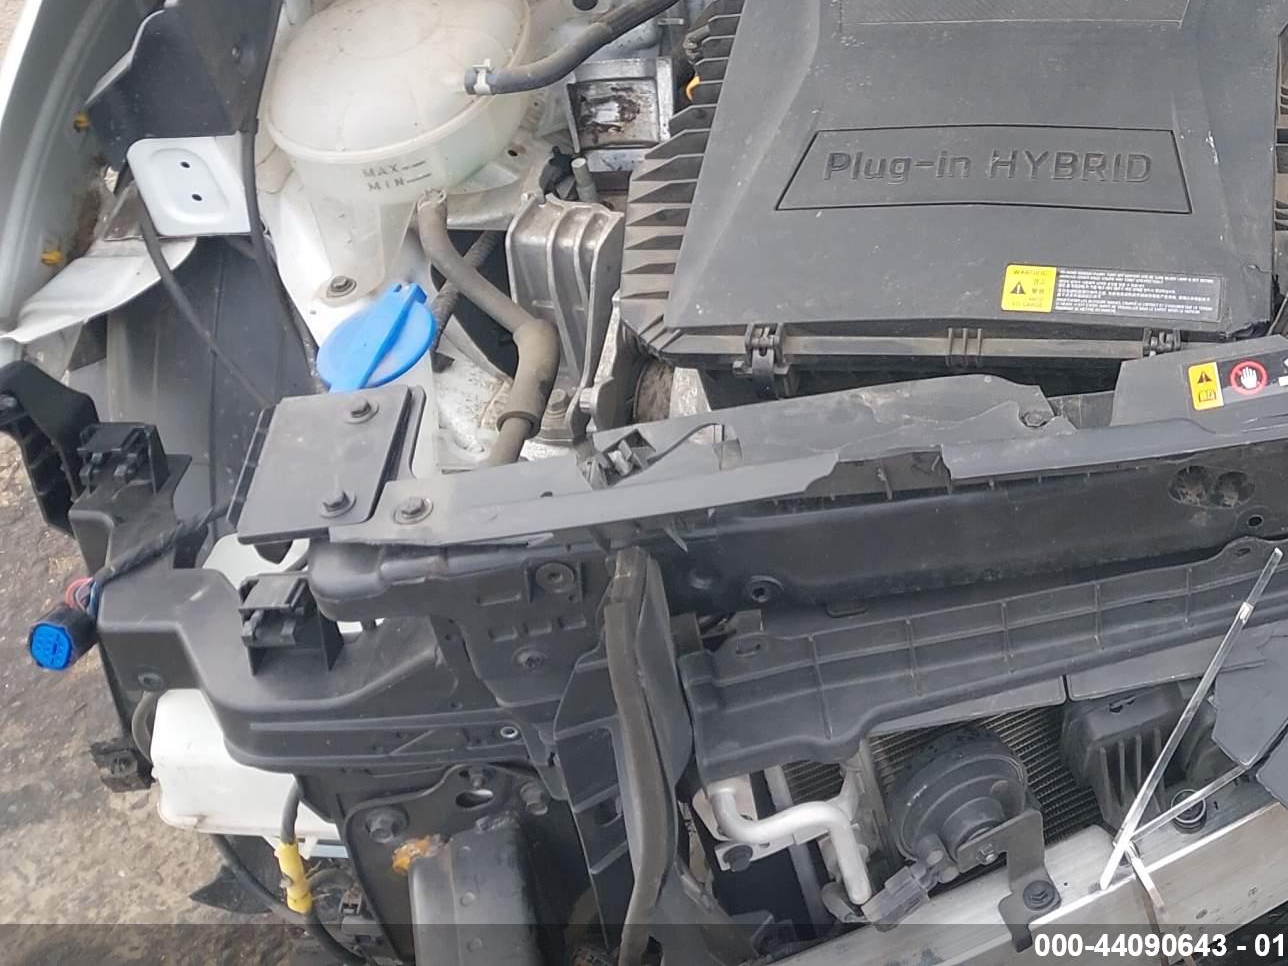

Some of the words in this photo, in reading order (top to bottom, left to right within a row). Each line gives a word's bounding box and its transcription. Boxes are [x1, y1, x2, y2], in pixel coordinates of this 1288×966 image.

[362, 163, 399, 177] MAX
[823, 149, 972, 185] Plug-in
[985, 149, 1153, 184] HYBRID
[368, 177, 404, 190] MIN
